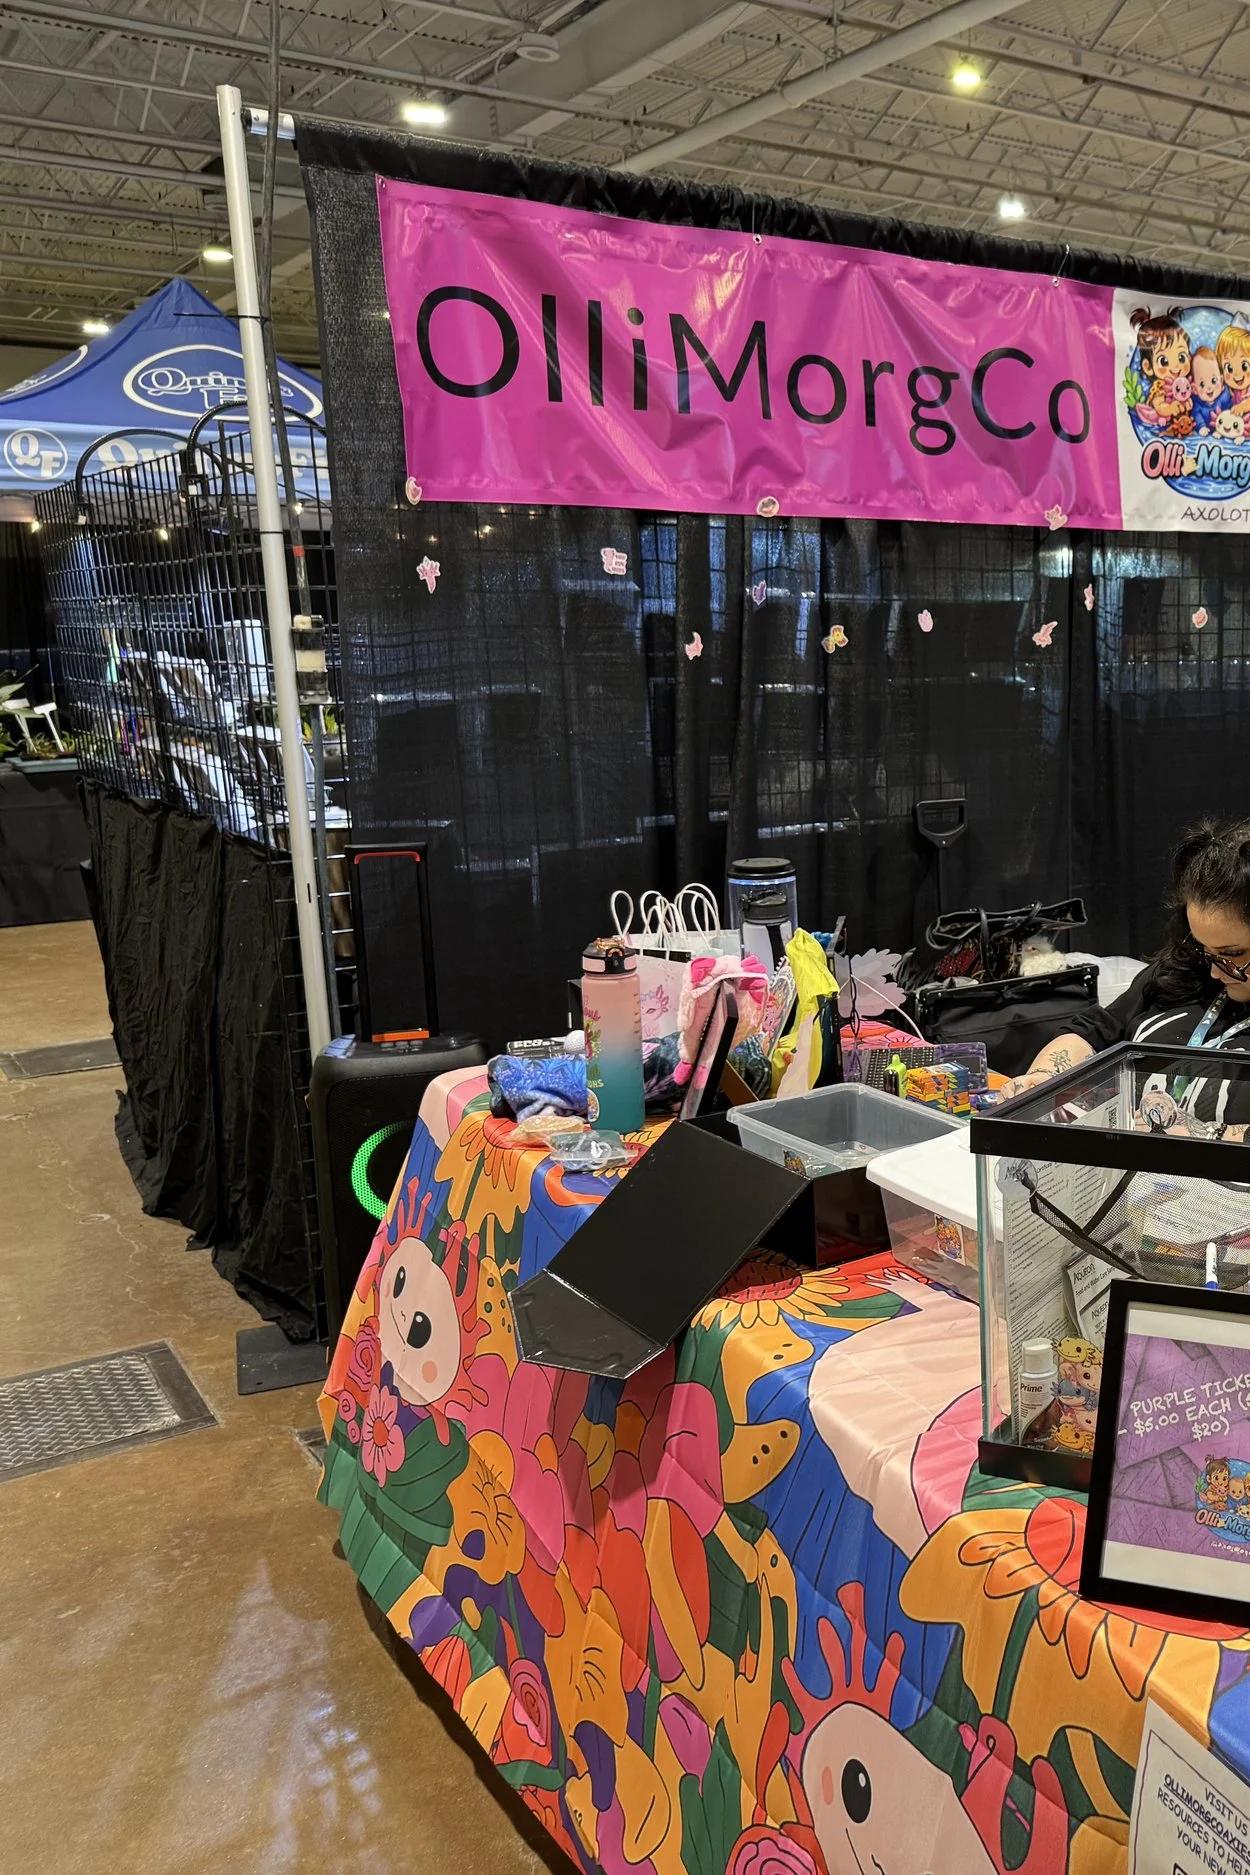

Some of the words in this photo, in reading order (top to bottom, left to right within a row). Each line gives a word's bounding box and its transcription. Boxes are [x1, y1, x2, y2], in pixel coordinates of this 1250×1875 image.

[416, 285, 1092, 457] OlliMorgCo
[1020, 1382, 1043, 1393] Prime
[1130, 1387, 1197, 1417] PURPLE
[1186, 1397, 1232, 1422] EACH
[1191, 1415, 1230, 1442] $20)
[1157, 1786, 1210, 1846] RESOURCES
[1211, 1839, 1226, 1859] TO
[1204, 1787, 1235, 1823] VISIT
[1234, 1817, 1249, 1838] US
[1176, 1826, 1202, 1862] YOUR
